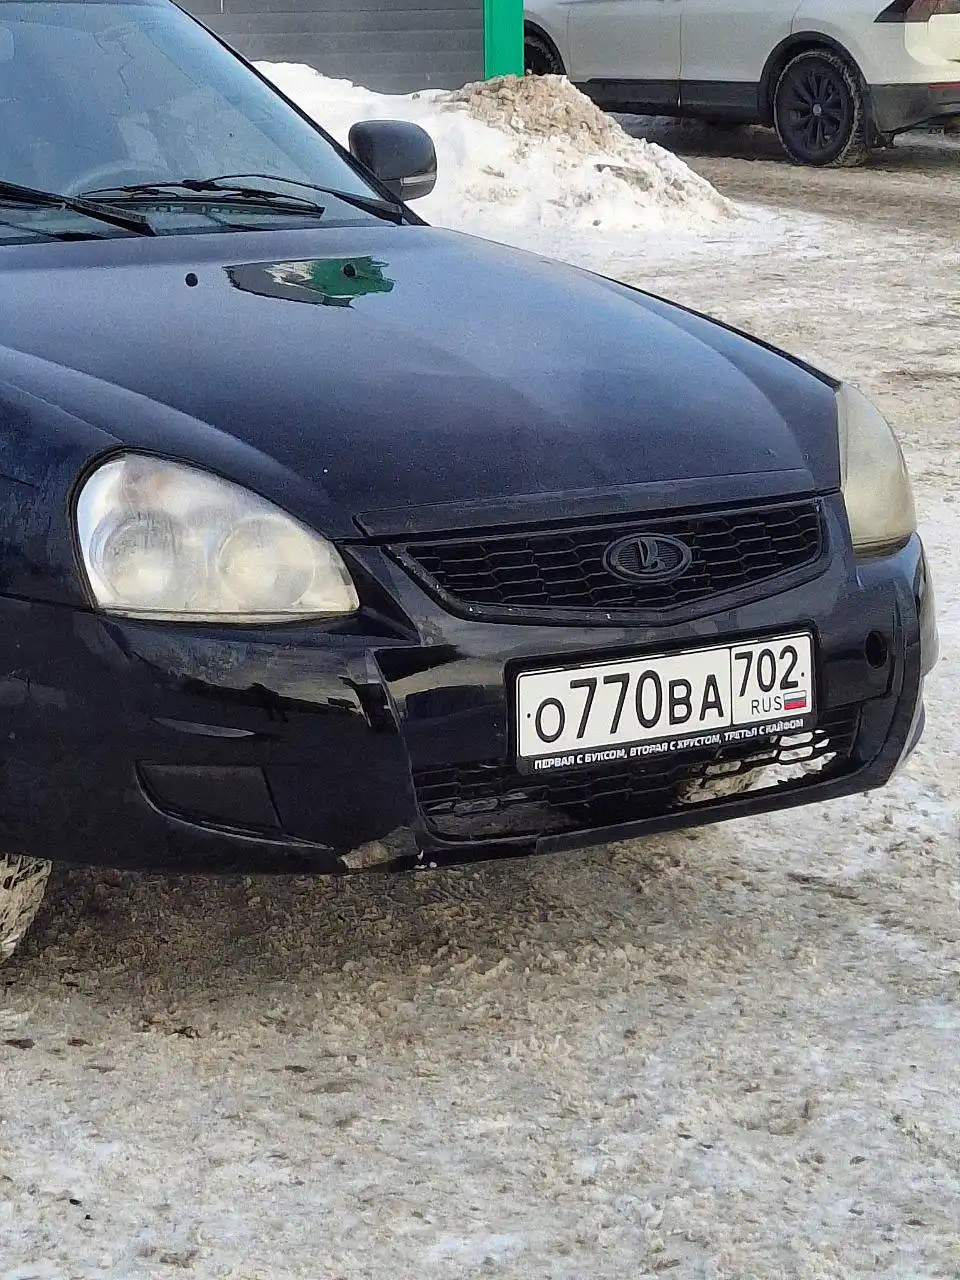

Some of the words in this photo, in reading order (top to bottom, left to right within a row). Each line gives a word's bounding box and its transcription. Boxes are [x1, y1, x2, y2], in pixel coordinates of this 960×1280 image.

[734, 644, 800, 698] 702
[750, 695, 783, 716] RUS
[534, 755, 575, 770] ПЕРВАЯ
[576, 754, 584, 764] С
[629, 742, 668, 757] ВТОРАЯ
[669, 740, 677, 751] С
